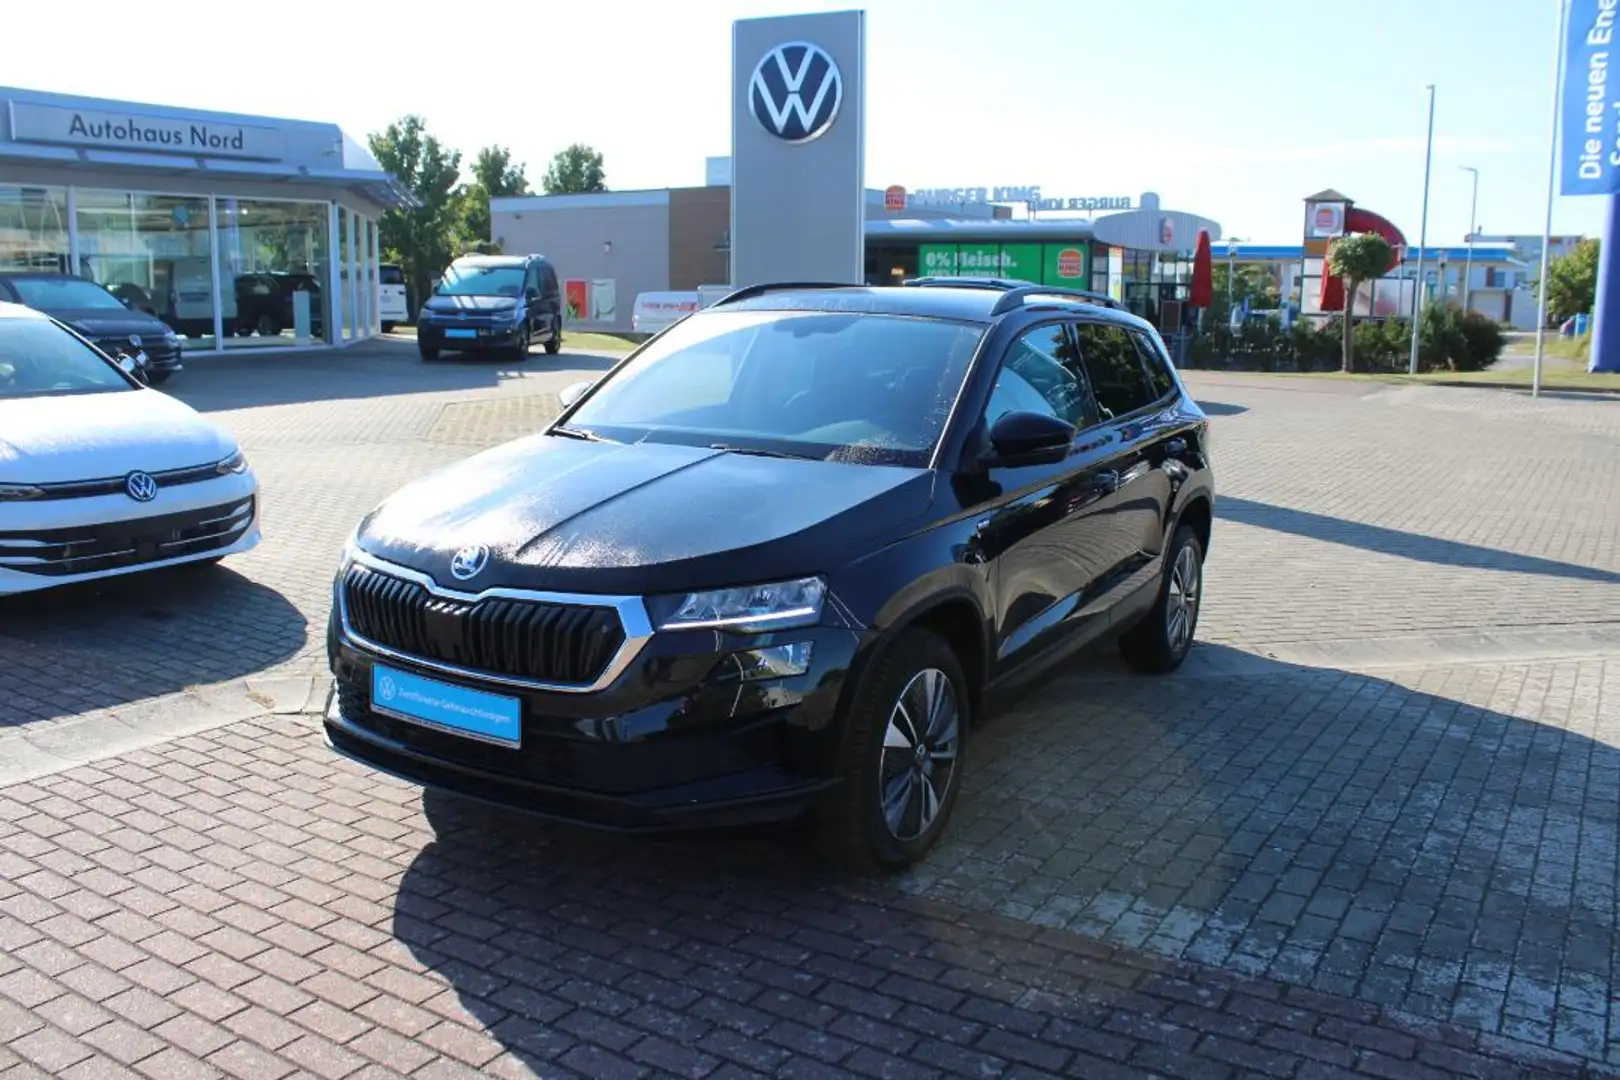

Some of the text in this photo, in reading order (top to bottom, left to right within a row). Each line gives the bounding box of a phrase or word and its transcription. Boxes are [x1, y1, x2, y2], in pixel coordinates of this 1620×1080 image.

[1585, 52, 1609, 133] neuen
[69, 114, 244, 150] Autohaus Nord
[1579, 139, 1602, 179] Die
[926, 252, 951, 267] 0%
